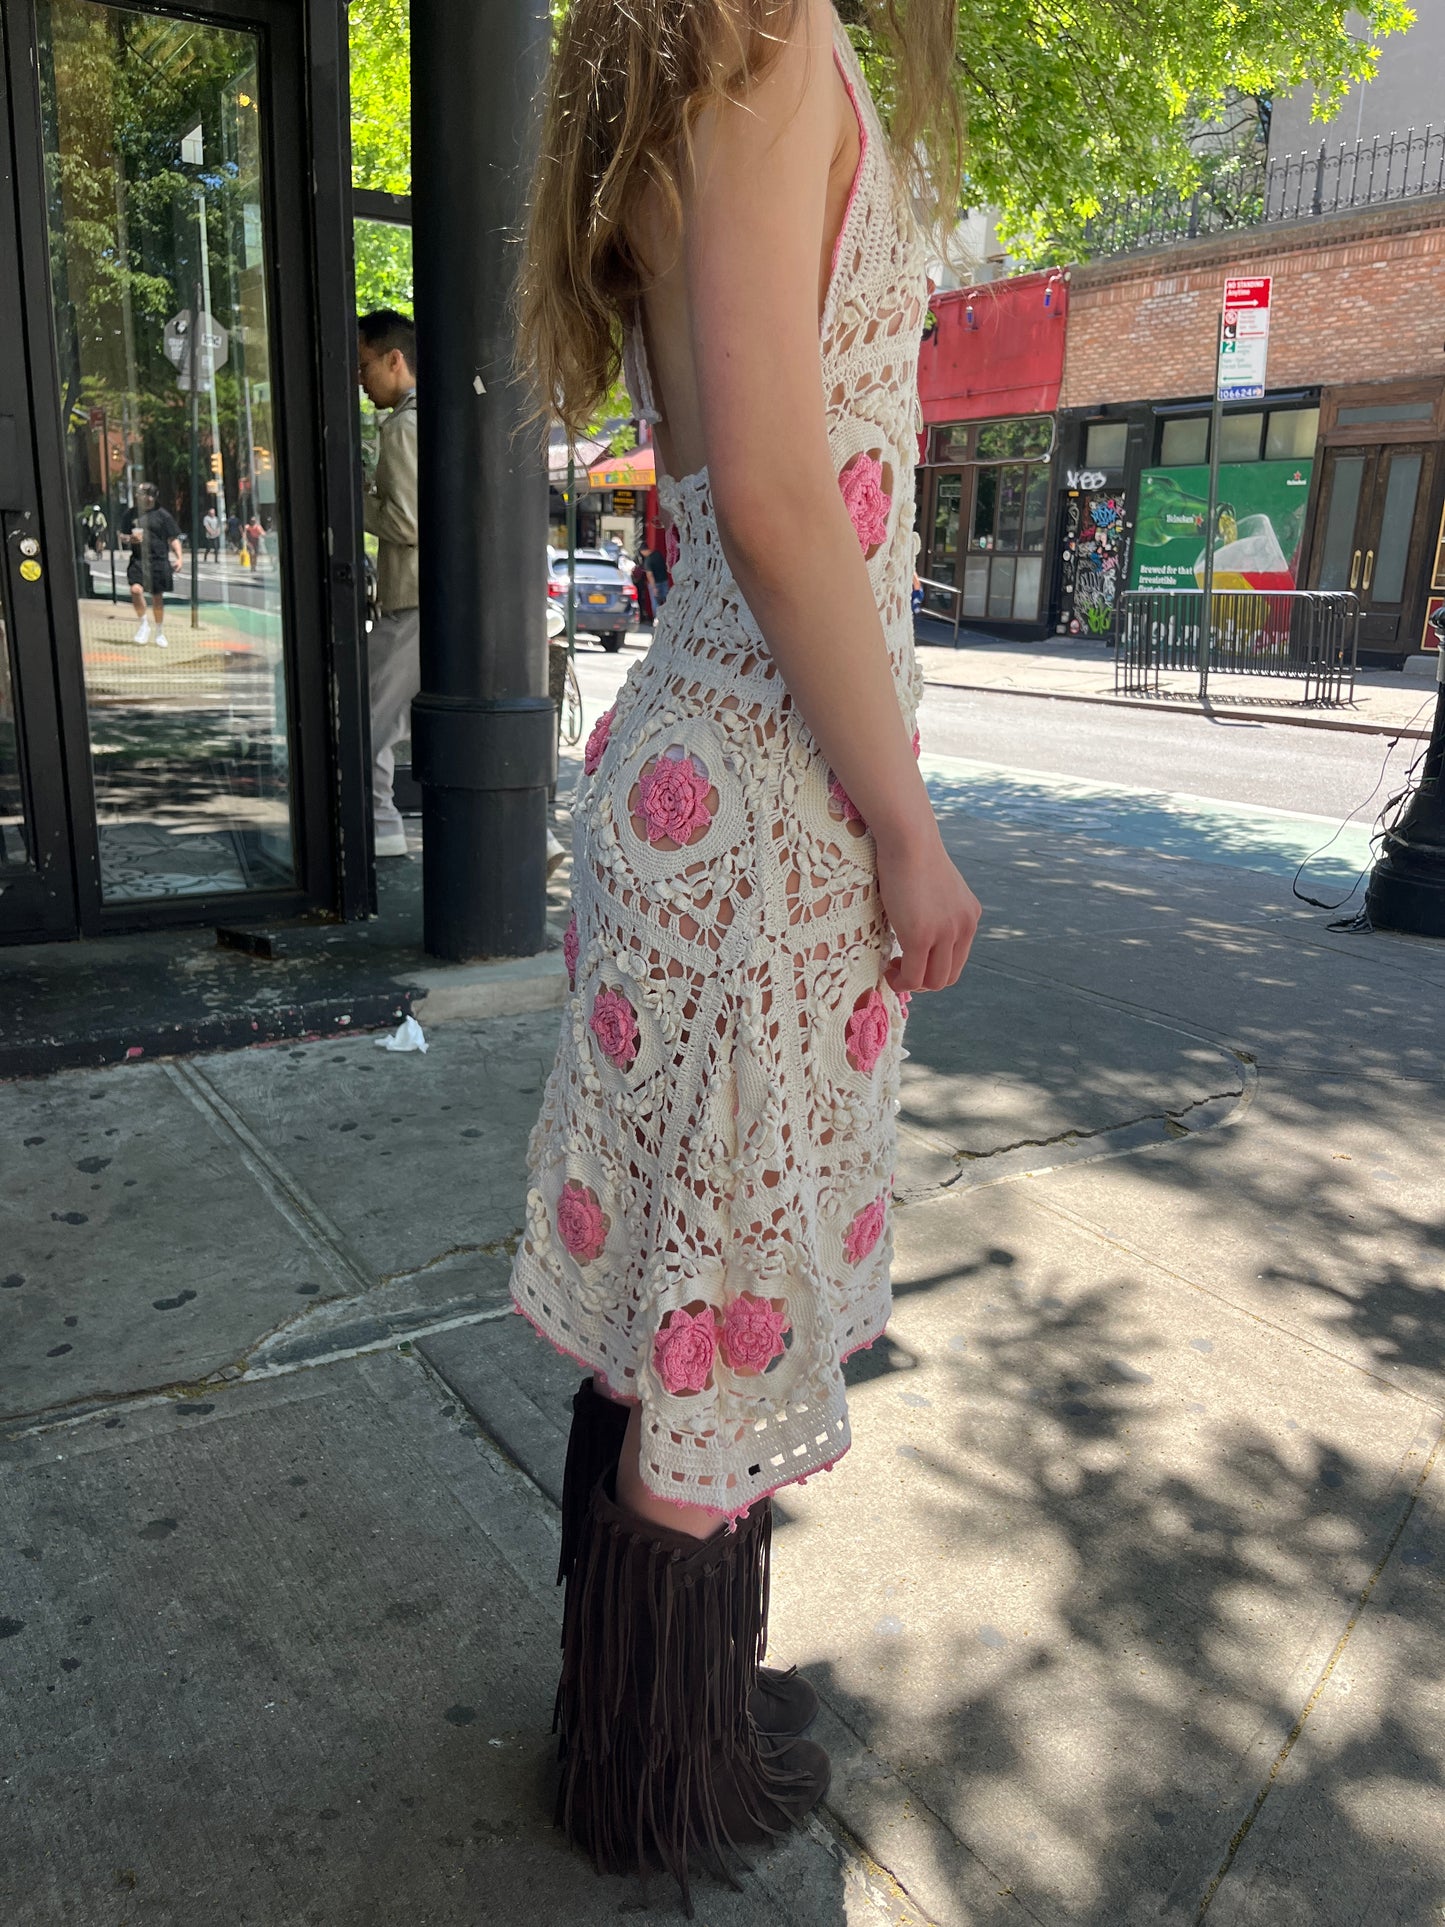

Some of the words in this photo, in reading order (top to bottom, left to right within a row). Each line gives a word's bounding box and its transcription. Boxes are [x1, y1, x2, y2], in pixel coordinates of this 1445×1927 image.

[1237, 280, 1264, 289] STANDING
[1225, 340, 1234, 352] 2
[1166, 514, 1194, 524] Heineken
[1140, 565, 1166, 574] Brewed
[1166, 565, 1177, 575] for
[1178, 566, 1193, 575] that
